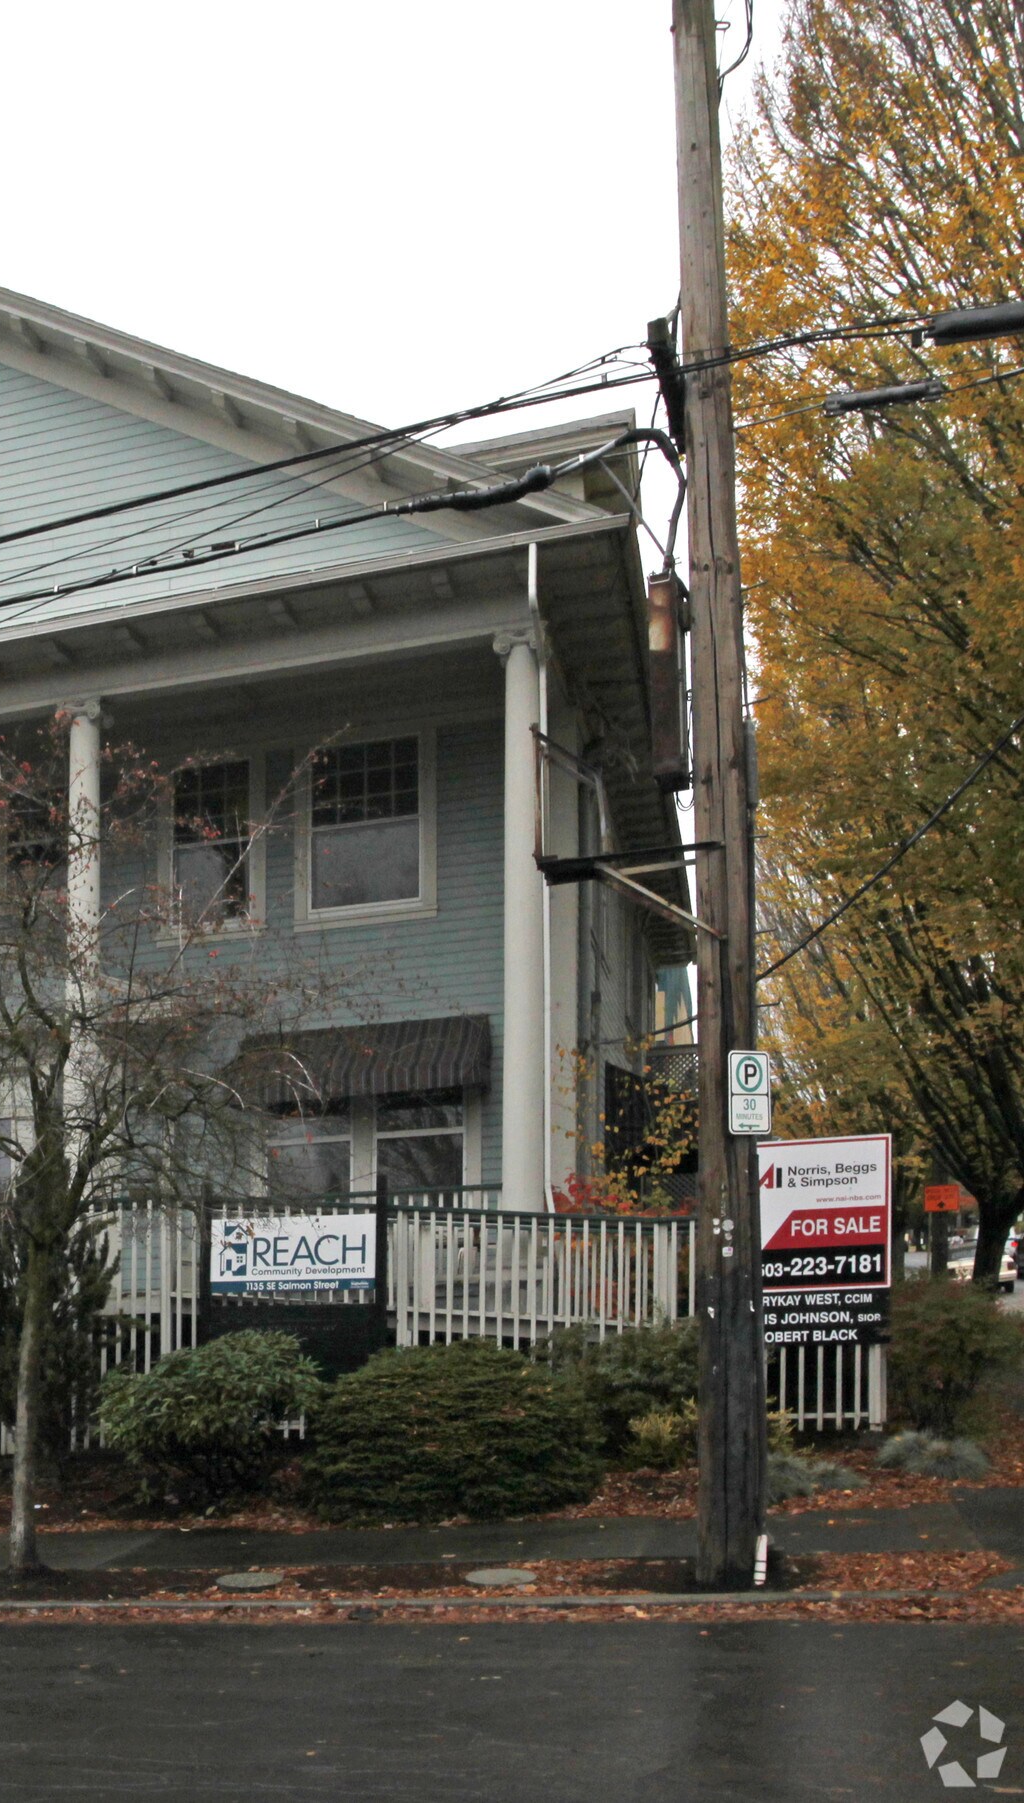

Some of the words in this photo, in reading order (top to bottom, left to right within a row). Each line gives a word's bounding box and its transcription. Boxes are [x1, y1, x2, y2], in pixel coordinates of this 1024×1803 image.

[744, 1064, 757, 1085] P
[743, 1098, 756, 1111] 30
[759, 1163, 782, 1189] AI
[787, 1164, 831, 1176] Norris,
[835, 1163, 877, 1175] Beggs
[787, 1177, 796, 1188] &
[800, 1176, 858, 1188] Simpson
[816, 1194, 882, 1203] www.nai-nbs.com
[791, 1218, 828, 1236] FOR
[834, 1216, 881, 1234] SALE
[253, 1234, 366, 1267] REACH
[251, 1267, 302, 1277] Community
[305, 1266, 365, 1275] Development
[246, 1282, 264, 1290] 1135
[266, 1282, 276, 1290] SE
[278, 1281, 311, 1290] Salmon
[313, 1281, 339, 1289] Street
[763, 1295, 801, 1306] RYKAY
[805, 1293, 841, 1306] WEST,
[844, 1293, 873, 1303] CCIM
[781, 1311, 854, 1324] JOHNSON,
[857, 1313, 881, 1321] SIOR
[764, 1330, 809, 1342] OBERT
[813, 1329, 858, 1341] BLACK
